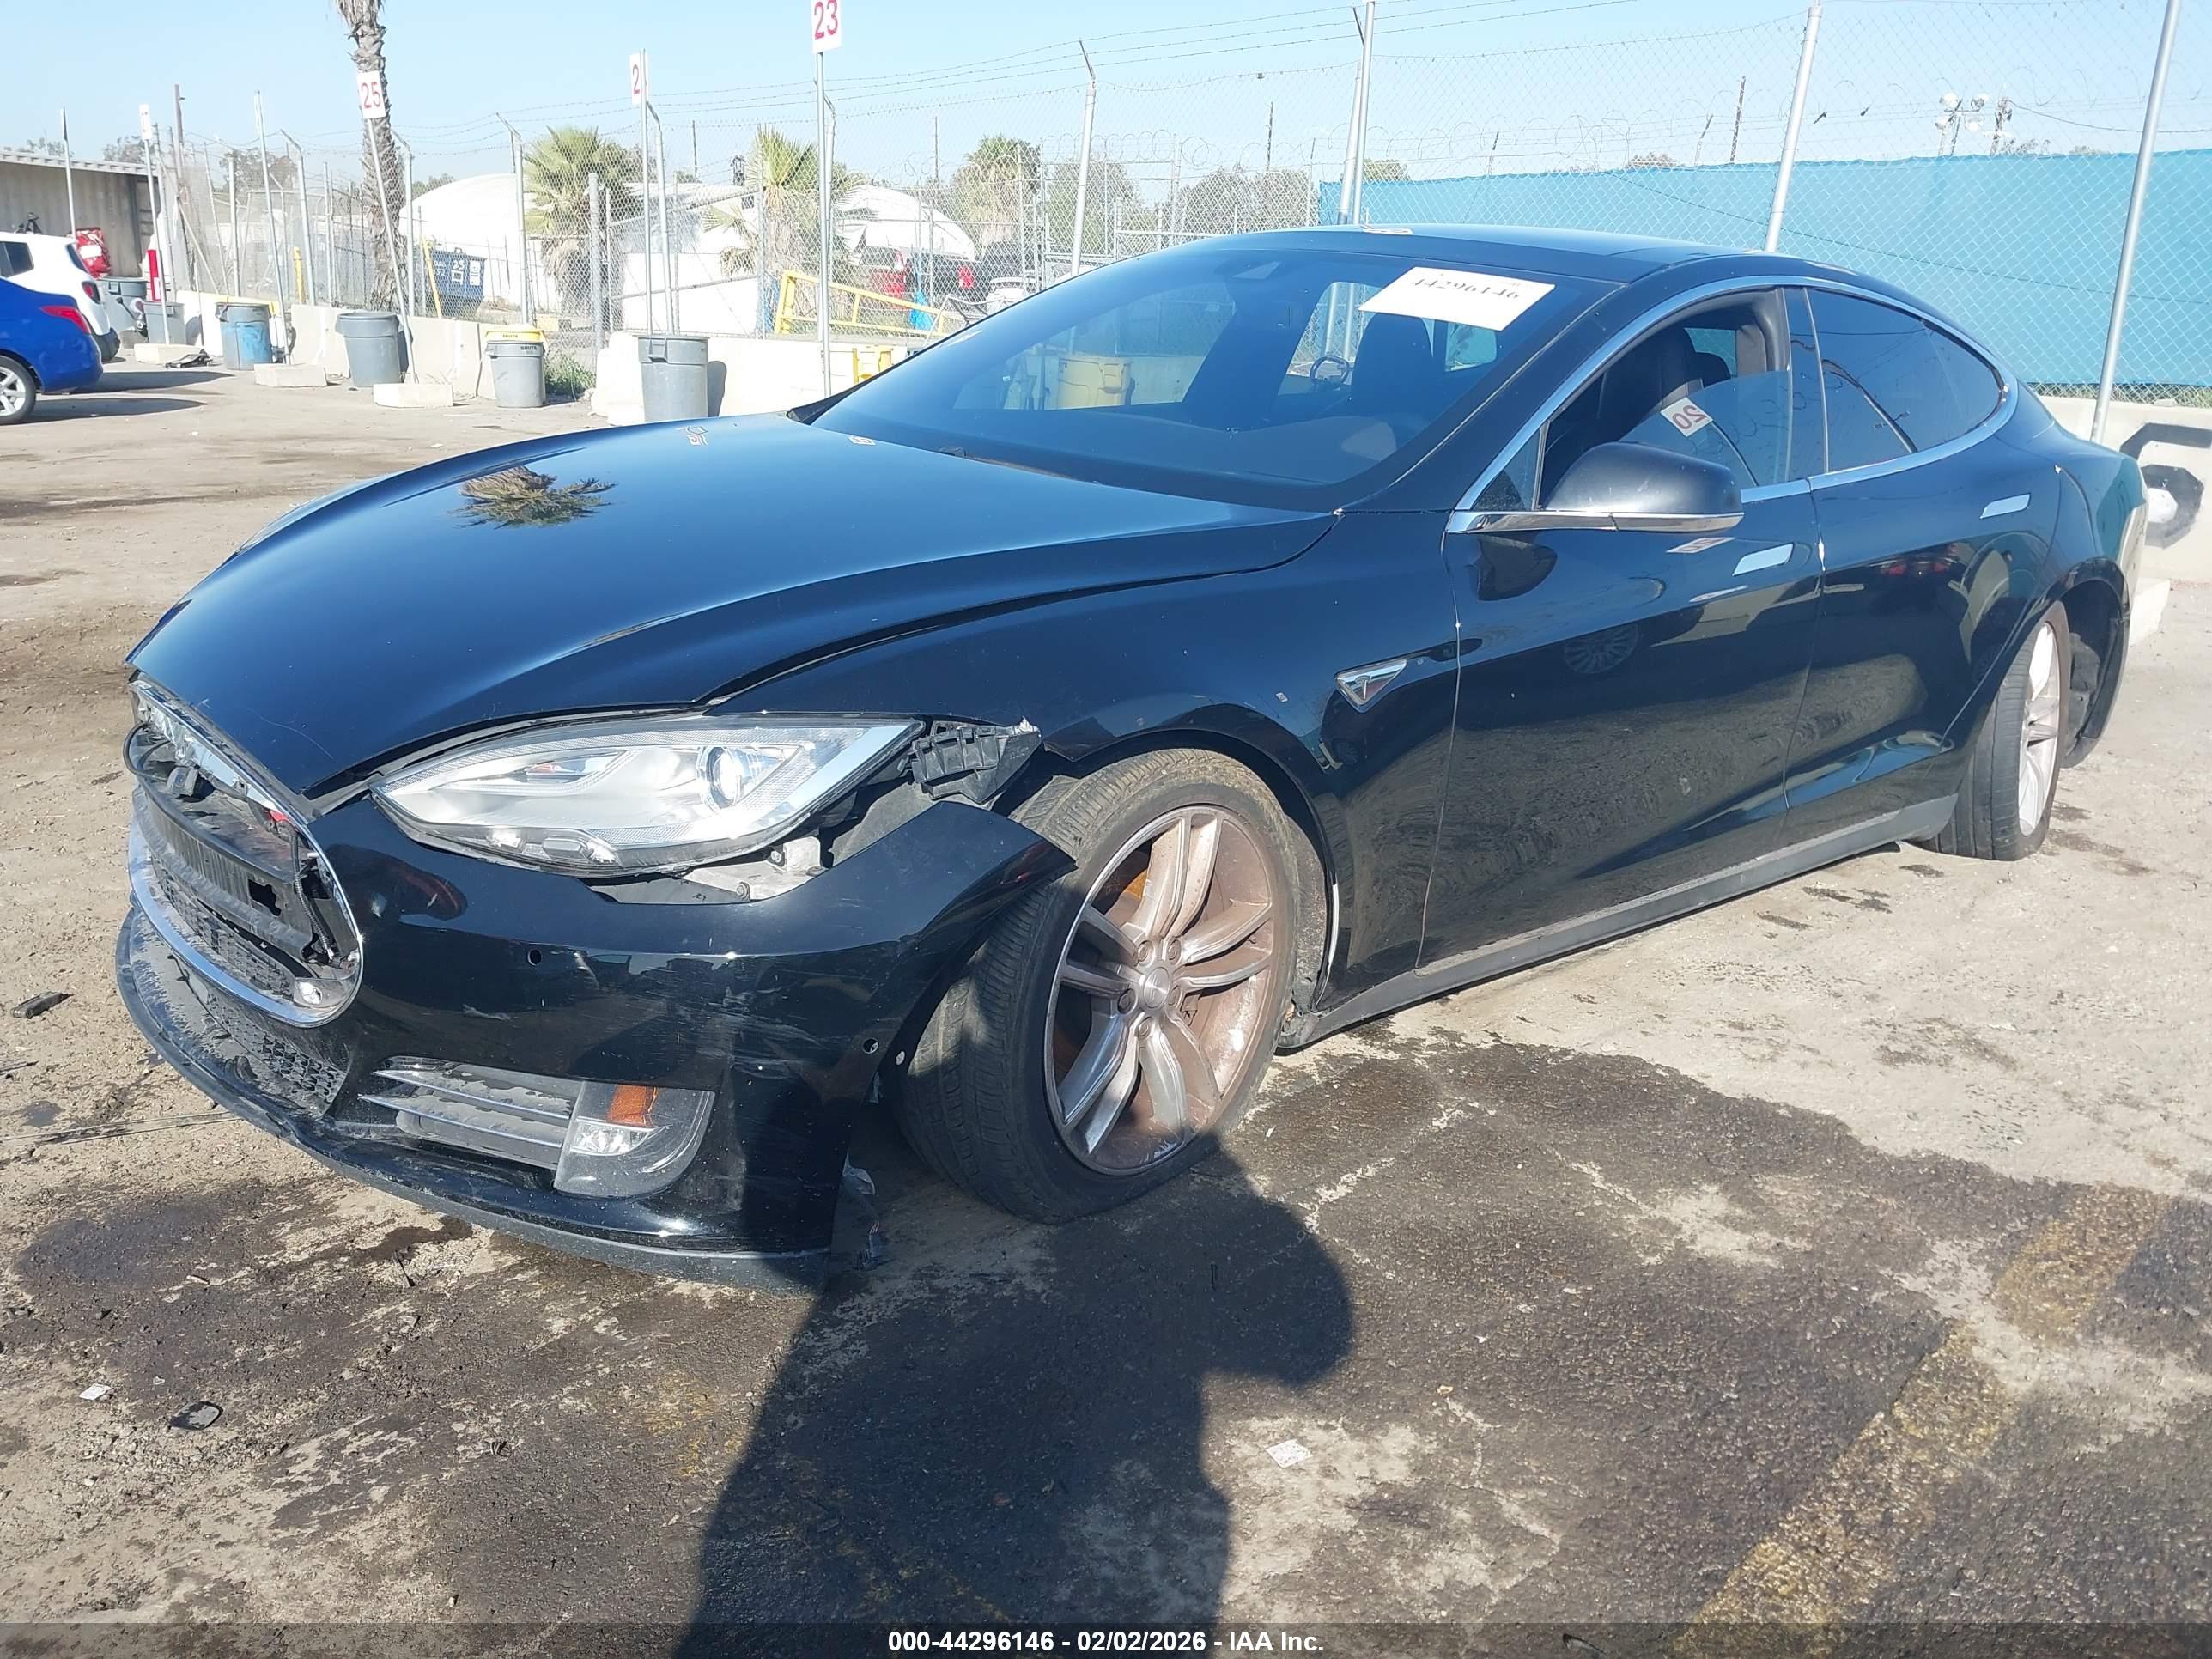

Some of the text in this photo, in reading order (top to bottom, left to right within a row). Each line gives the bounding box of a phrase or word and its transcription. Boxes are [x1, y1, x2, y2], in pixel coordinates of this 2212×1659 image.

[813, 0, 838, 40] 23
[360, 81, 381, 109] 25
[1408, 277, 1520, 299] 44296146
